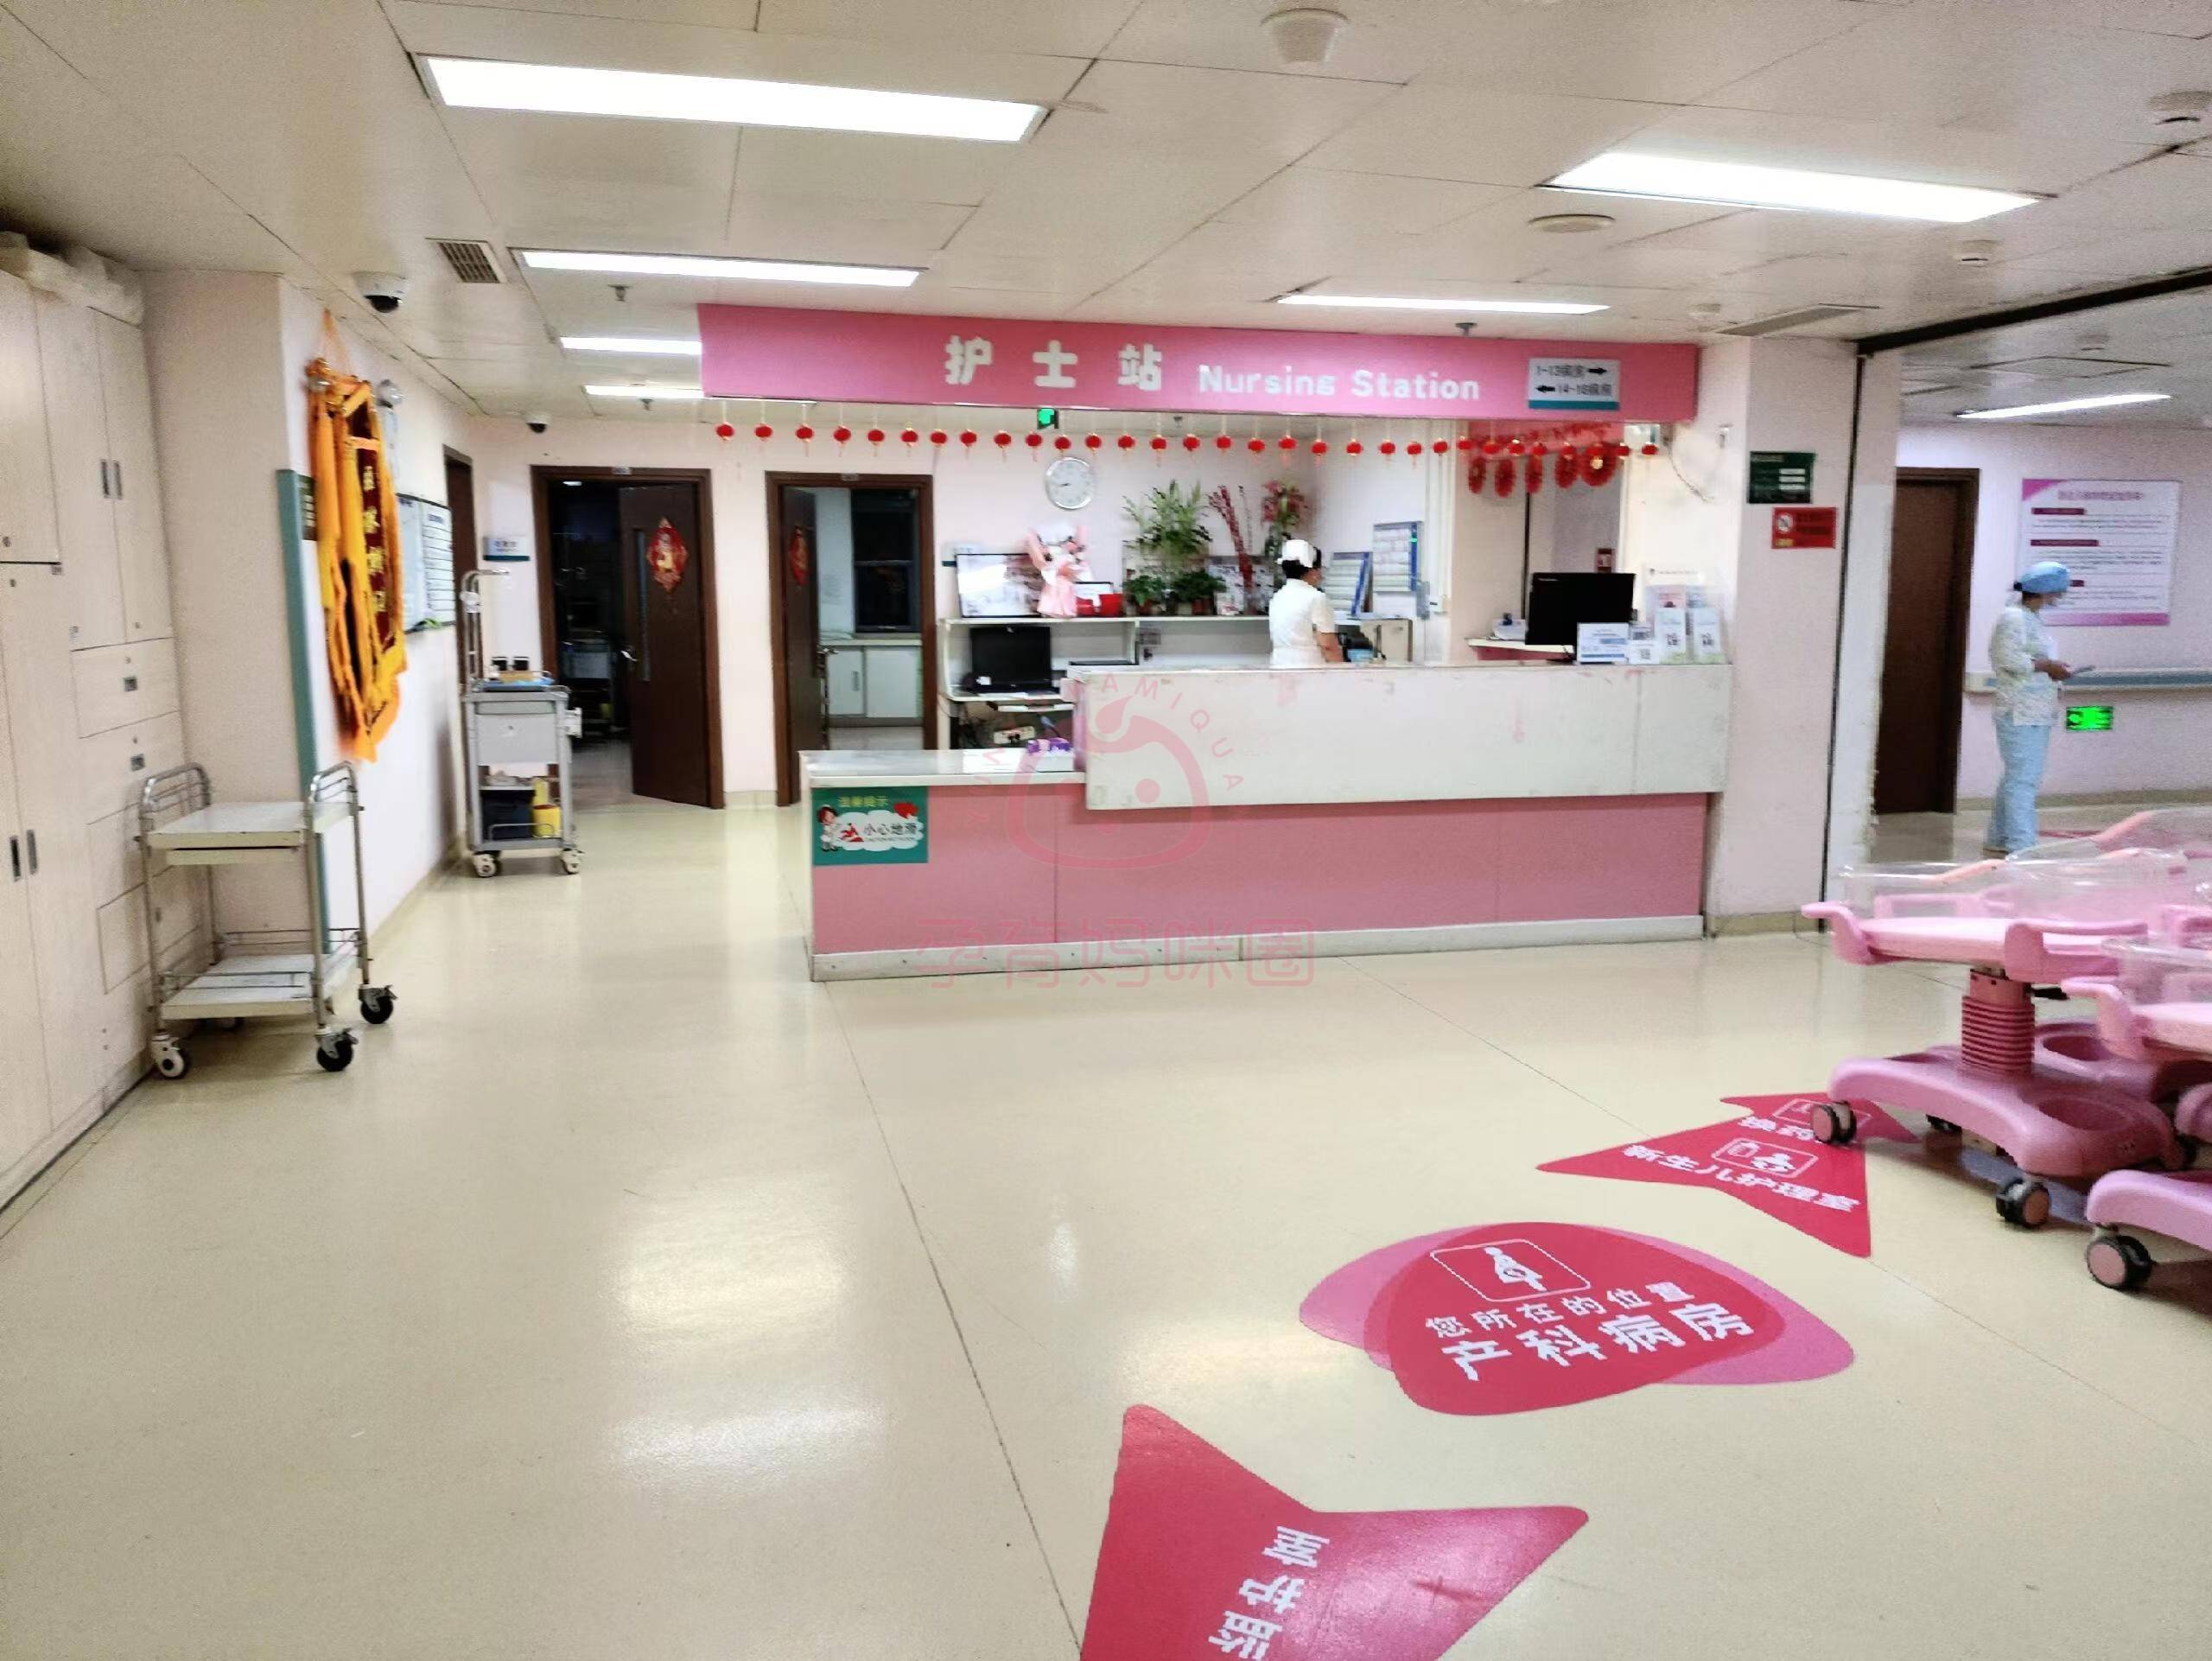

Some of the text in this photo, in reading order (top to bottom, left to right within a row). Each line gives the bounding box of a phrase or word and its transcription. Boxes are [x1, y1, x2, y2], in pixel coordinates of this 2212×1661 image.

[944, 335, 1163, 391] 护士站
[1198, 363, 1481, 401] Nursing Station
[1425, 1282, 1695, 1339] 您所在的位置
[1440, 1301, 1755, 1381] 产科病房
[1208, 1525, 1331, 1660] 监护室
